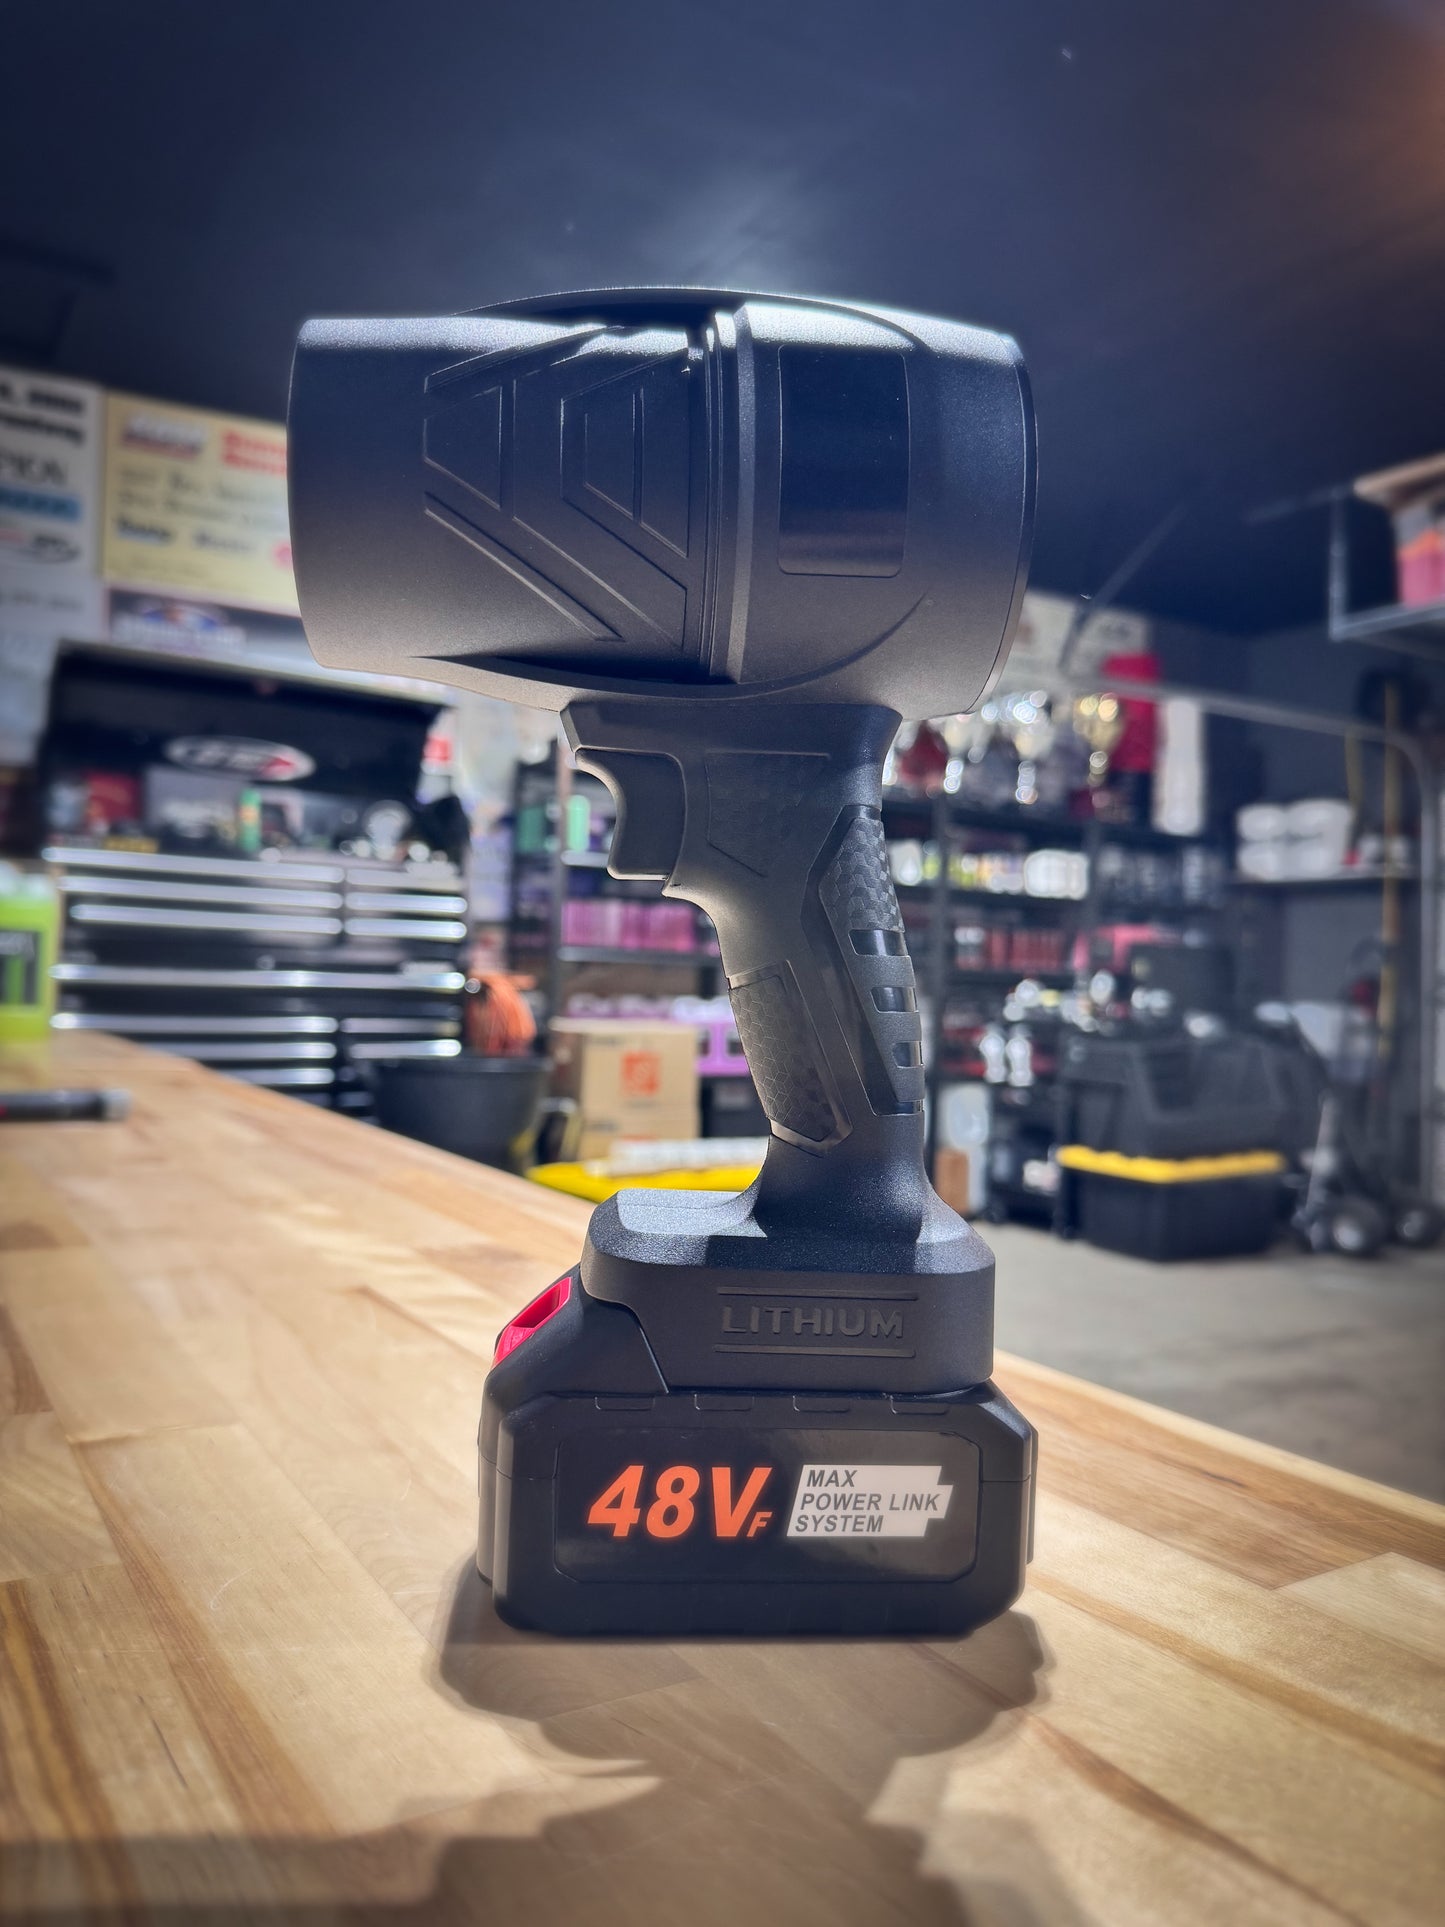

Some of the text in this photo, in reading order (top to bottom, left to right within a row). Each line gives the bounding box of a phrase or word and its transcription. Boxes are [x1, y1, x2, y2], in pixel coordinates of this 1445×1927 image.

[721, 1306, 904, 1338] LITHIUM
[806, 1469, 858, 1488] MAX
[800, 1492, 941, 1511] POWER LINK
[795, 1514, 884, 1533] SYSTEM
